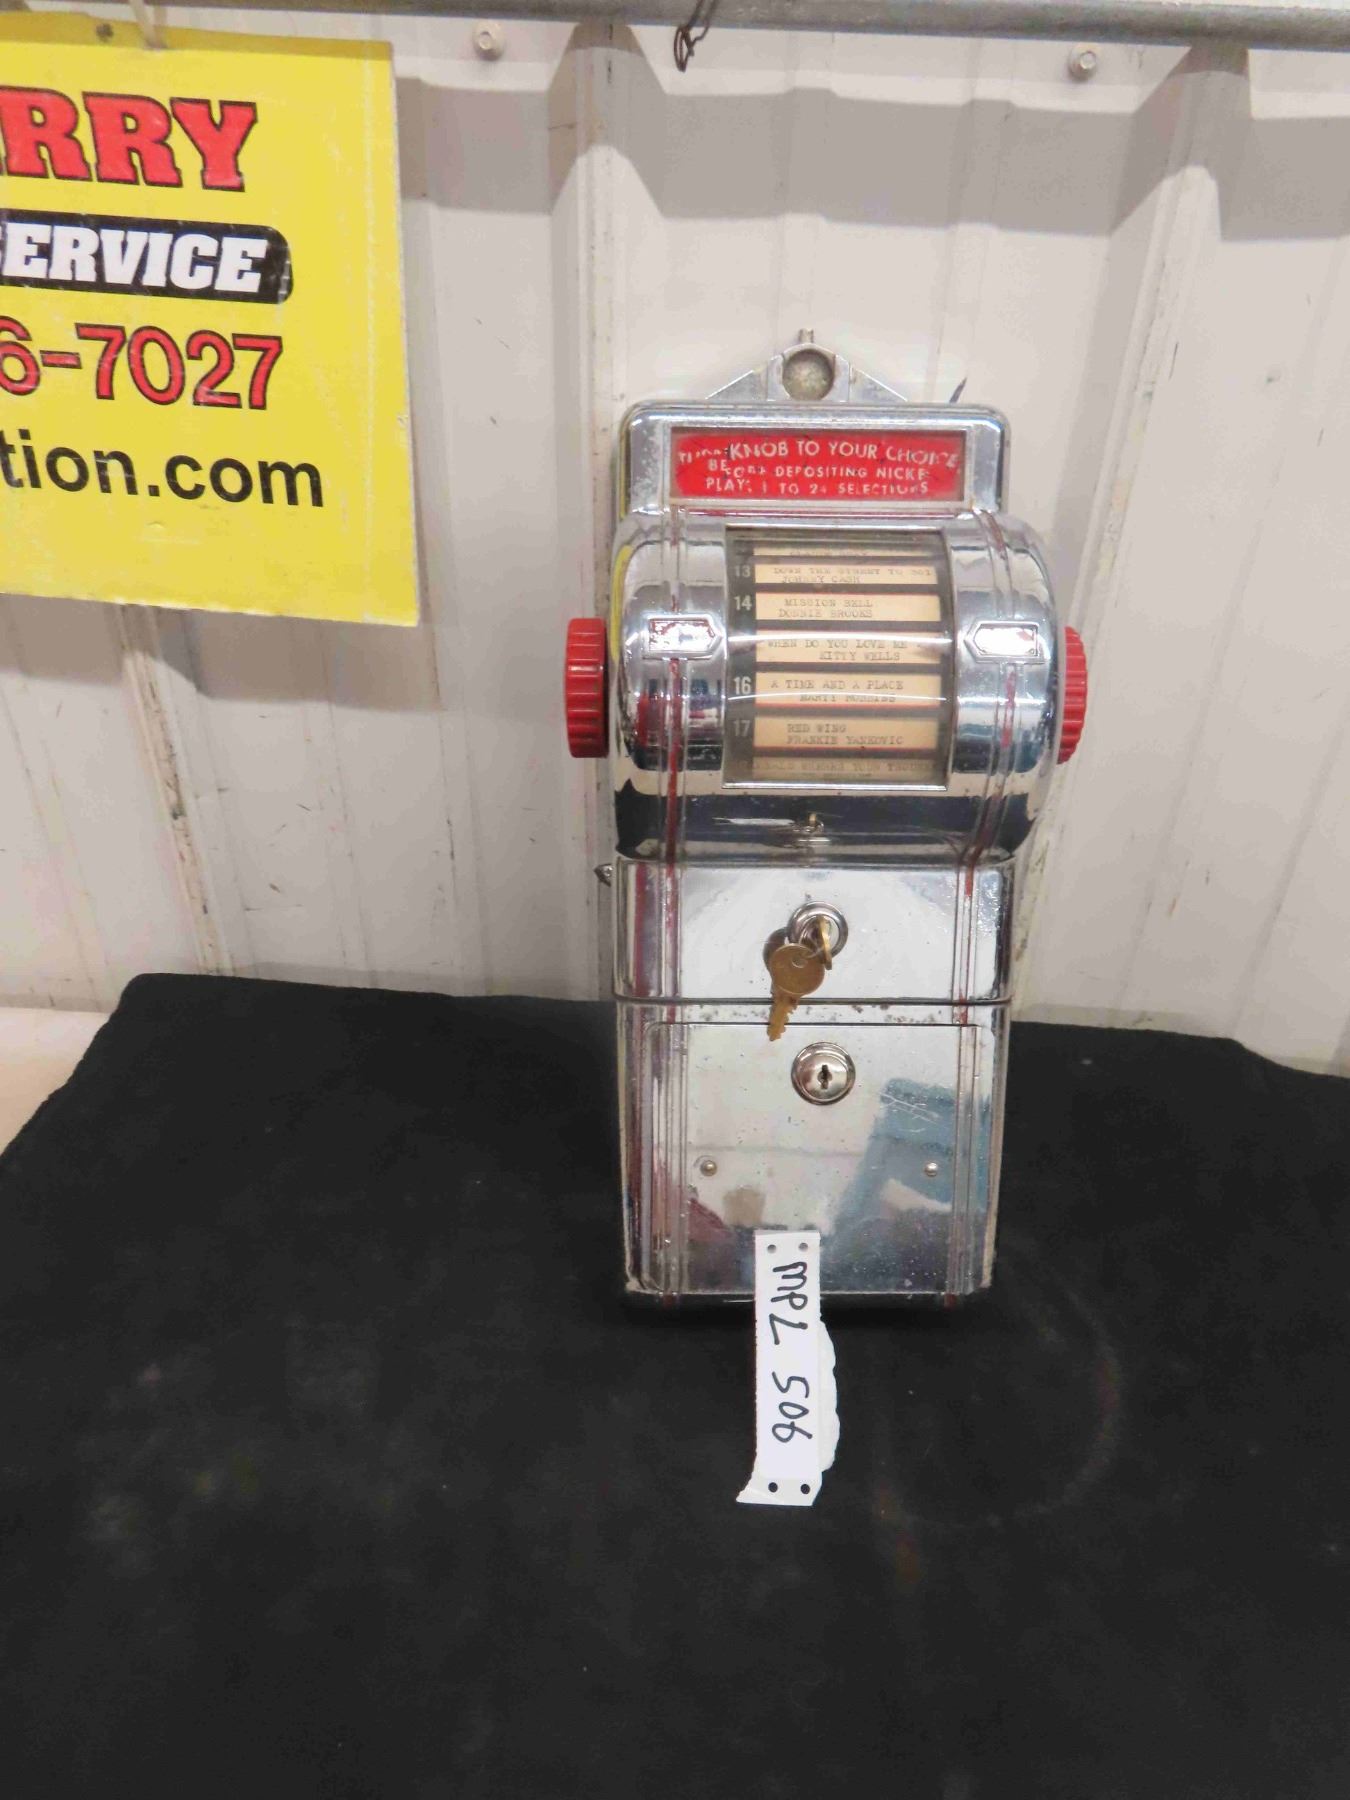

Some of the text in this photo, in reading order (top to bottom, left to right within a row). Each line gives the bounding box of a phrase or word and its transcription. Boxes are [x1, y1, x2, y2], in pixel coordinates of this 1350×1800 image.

[0, 86, 258, 192] RRY
[0, 221, 268, 294] ERVICE
[730, 441, 790, 461] KNOB
[797, 440, 820, 457] TO
[828, 441, 878, 460] YOUR
[0, 428, 324, 508] tion.com
[775, 466, 868, 479] DEPOSITING
[779, 482, 800, 495] TO
[734, 565, 751, 579] 13
[734, 596, 752, 611] 14
[805, 639, 819, 648] DO
[828, 639, 848, 648] YOU
[856, 640, 886, 649] LOVE
[734, 676, 751, 695] 16
[734, 719, 750, 736] 17
[771, 1371, 813, 1443] 506
